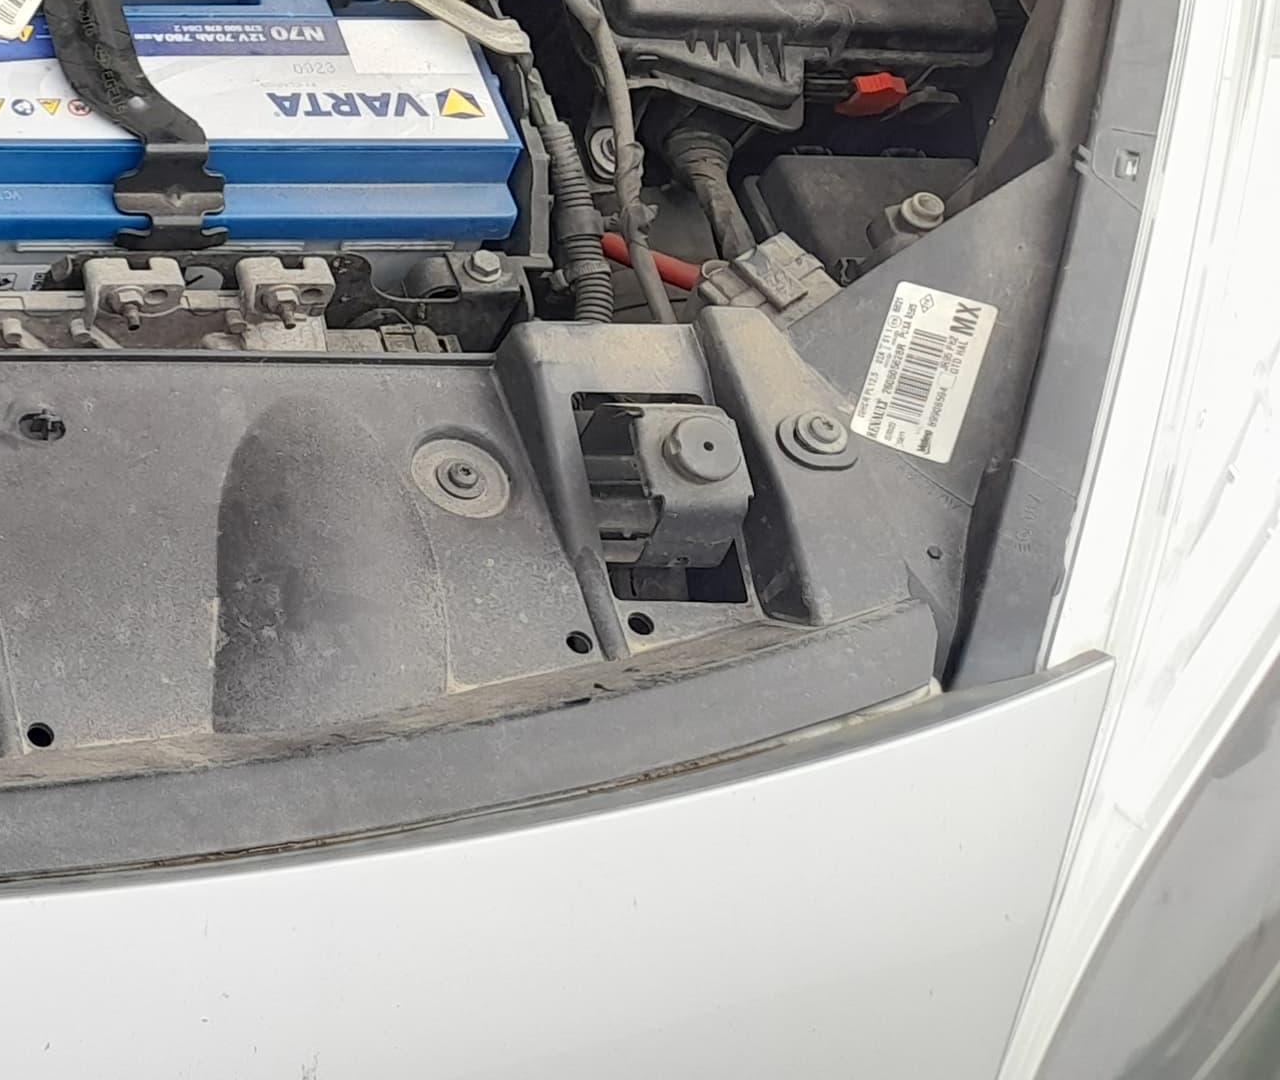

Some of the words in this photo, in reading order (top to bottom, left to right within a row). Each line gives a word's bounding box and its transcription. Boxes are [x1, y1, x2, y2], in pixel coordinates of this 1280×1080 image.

[196, 33, 235, 43] 70Ah
[239, 33, 266, 43] 12V
[270, 25, 325, 41] N70
[266, 92, 428, 118] VARTA
[950, 302, 982, 337] MX
[865, 398, 889, 438] RENAULT
